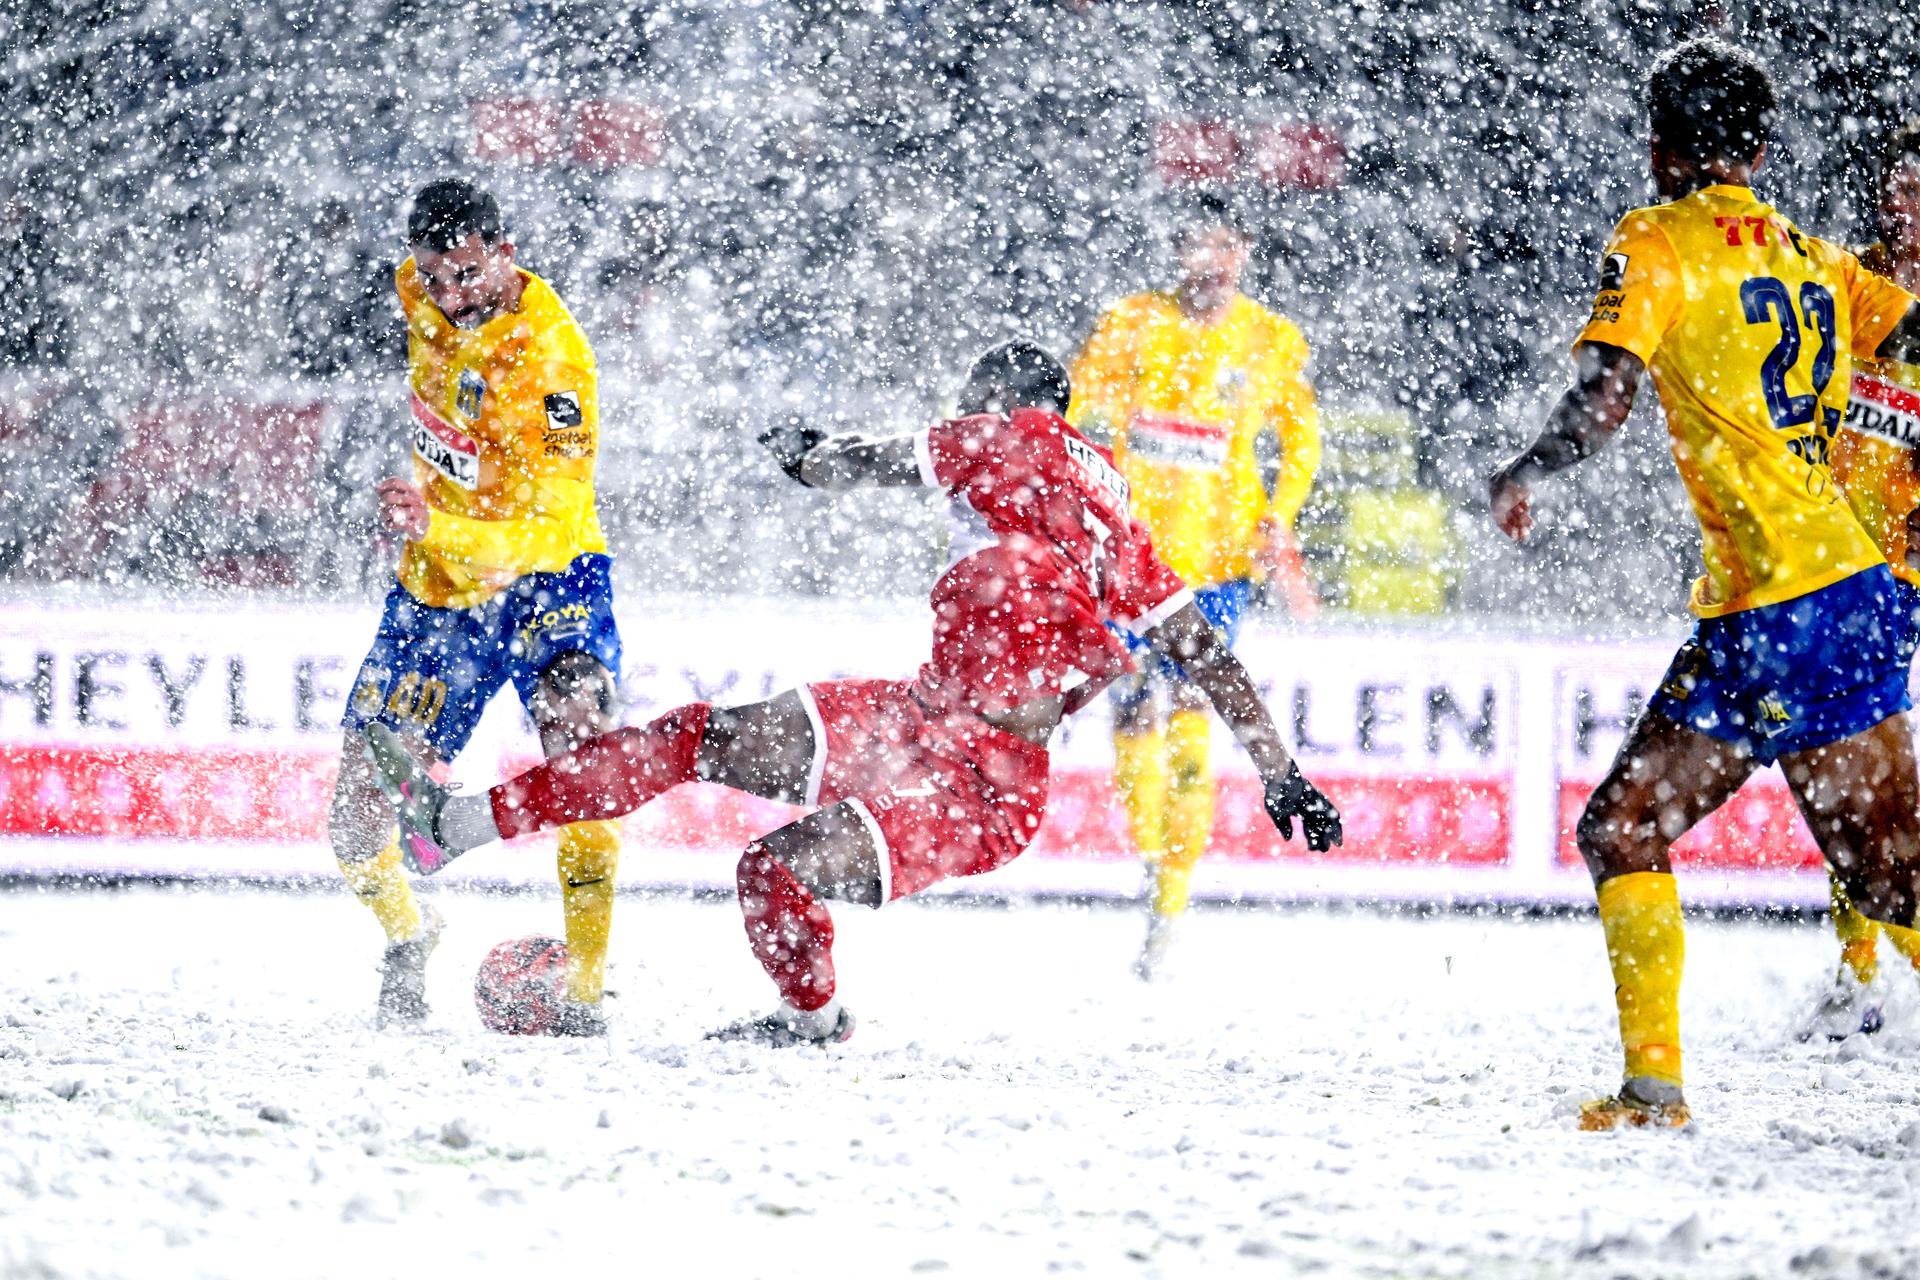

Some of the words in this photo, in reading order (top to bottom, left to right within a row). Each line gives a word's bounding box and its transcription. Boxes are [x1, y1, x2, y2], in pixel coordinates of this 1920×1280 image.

[1740, 276, 1842, 438] 22
[1845, 400, 1917, 446] UDAL
[0, 648, 348, 732] HEYLE
